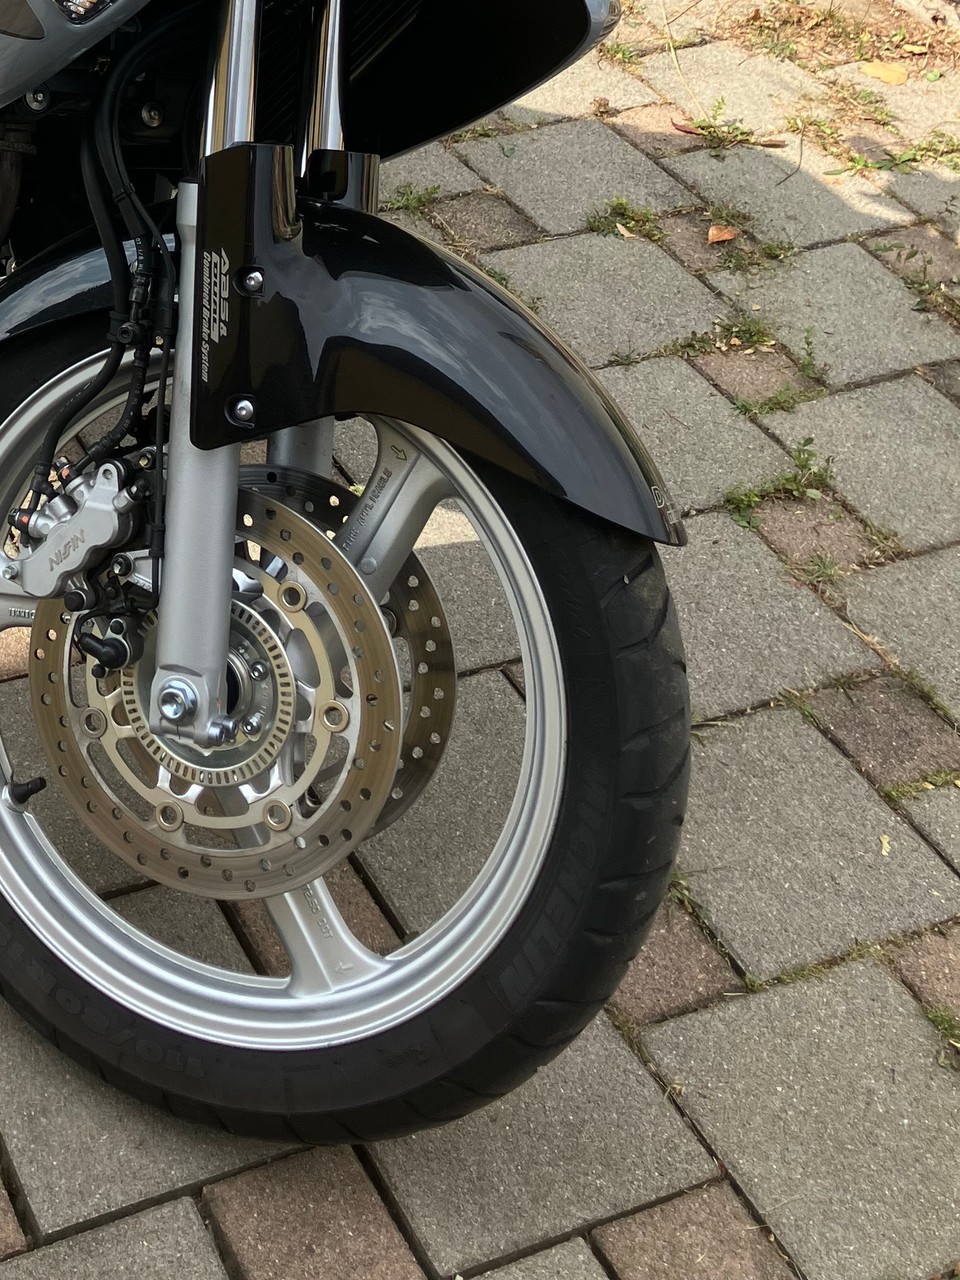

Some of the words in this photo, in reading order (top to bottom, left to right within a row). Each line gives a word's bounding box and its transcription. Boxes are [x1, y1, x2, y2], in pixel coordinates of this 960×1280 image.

[203, 251, 211, 308] Combined
[210, 254, 221, 341] DUAL
[202, 307, 211, 342] Brake
[201, 341, 210, 383] System
